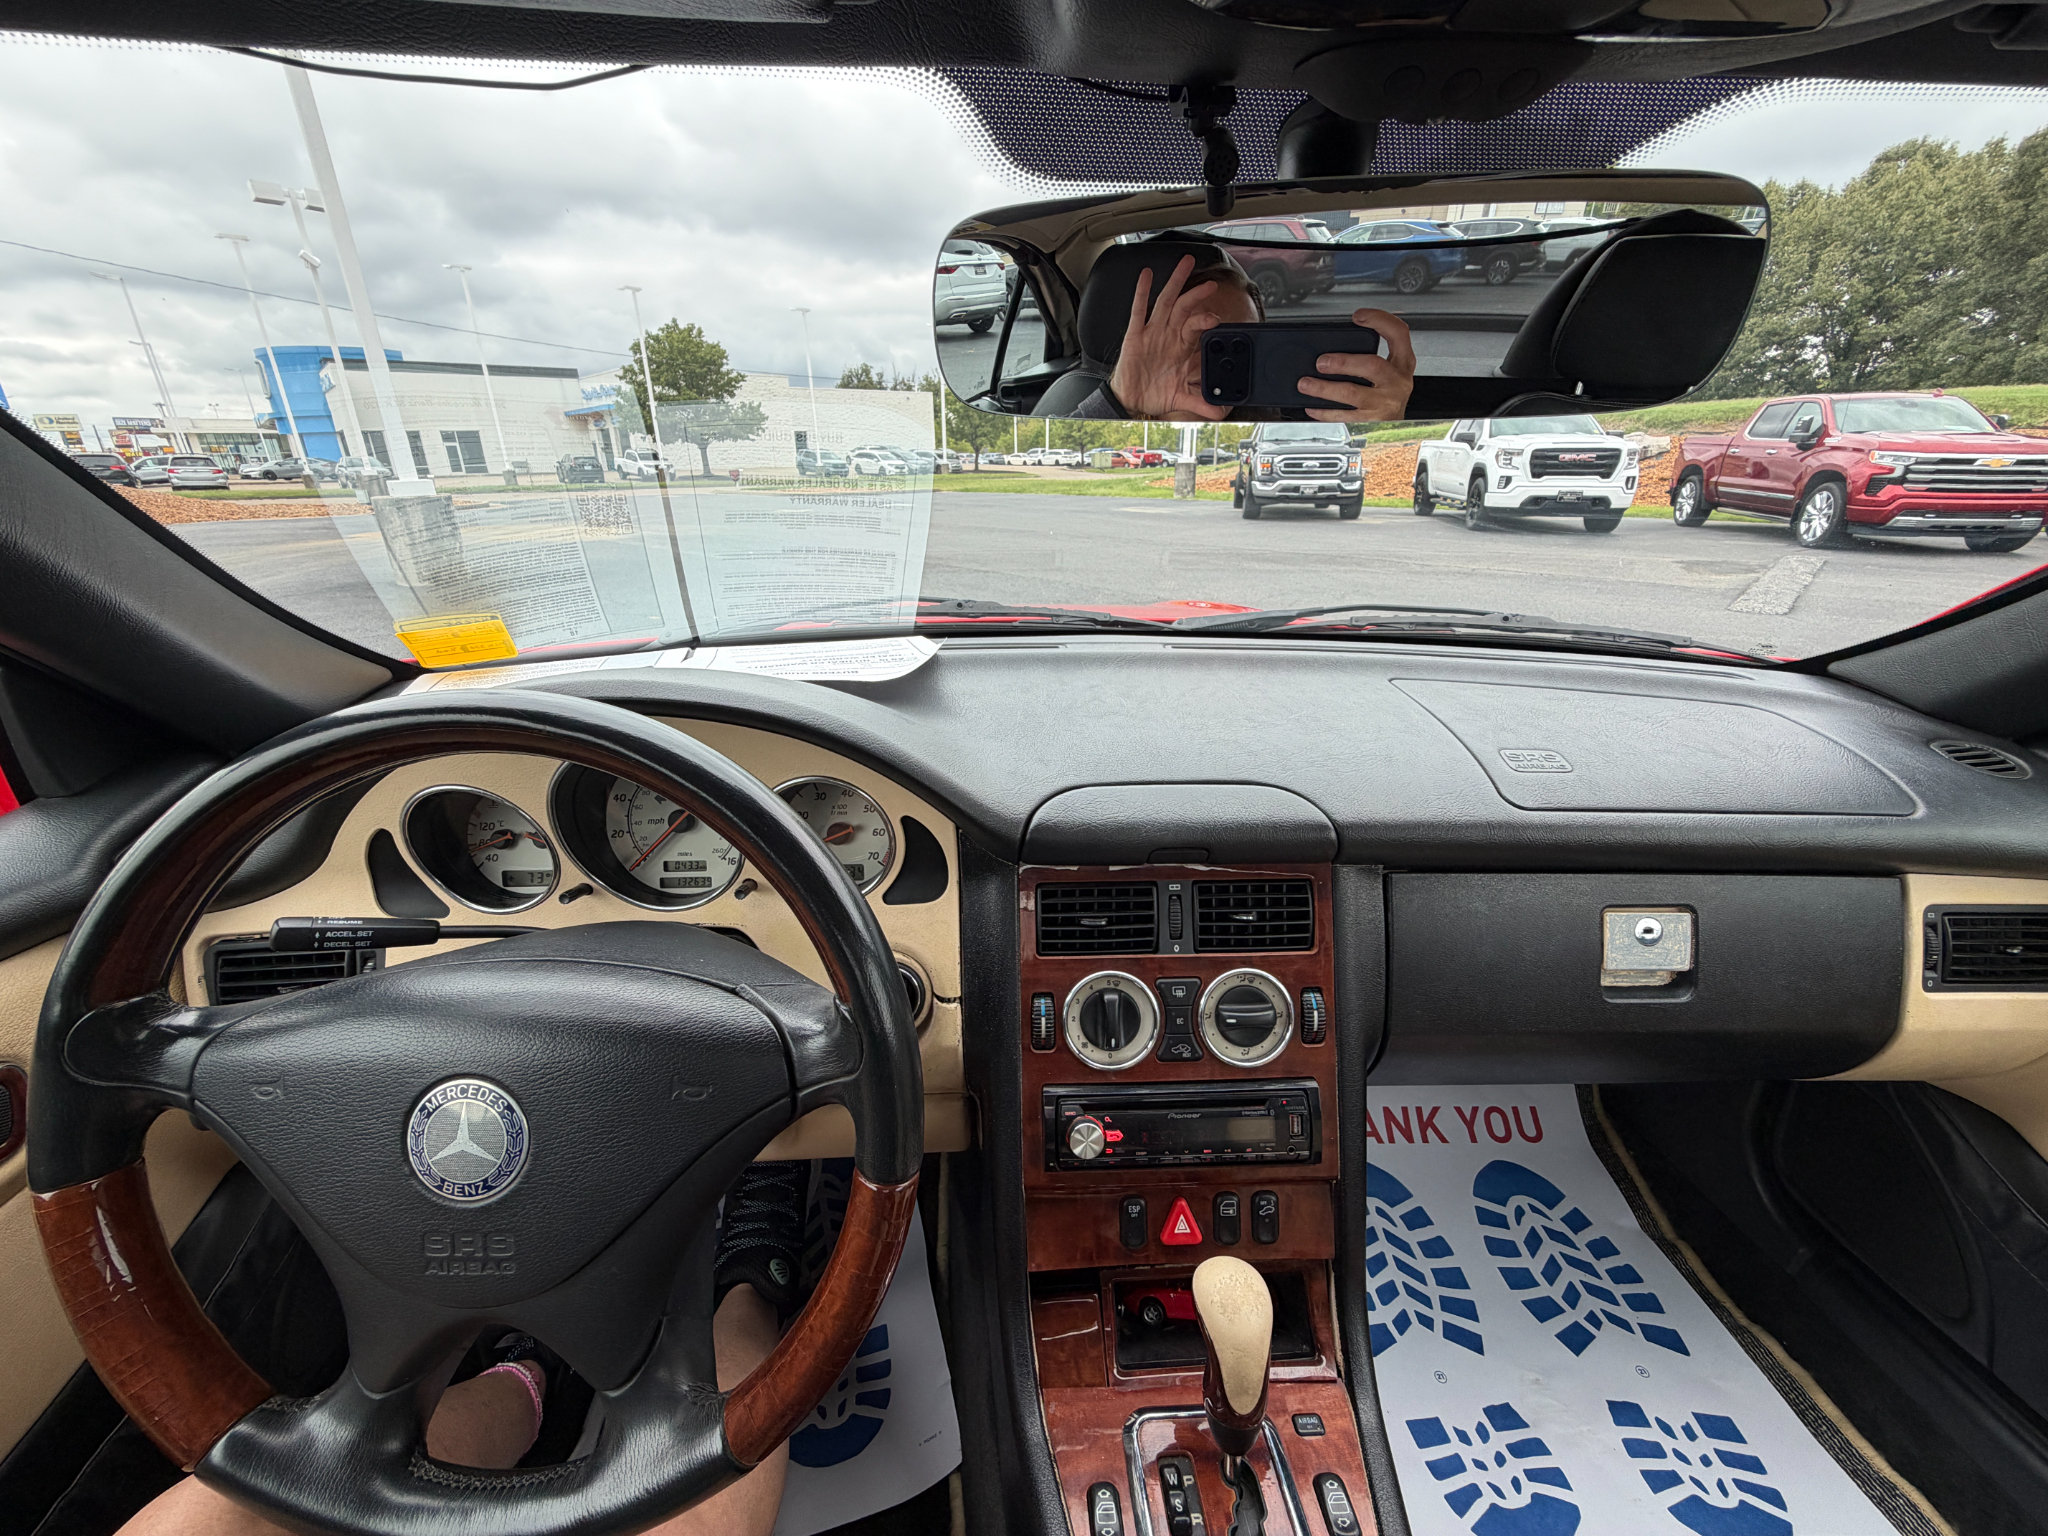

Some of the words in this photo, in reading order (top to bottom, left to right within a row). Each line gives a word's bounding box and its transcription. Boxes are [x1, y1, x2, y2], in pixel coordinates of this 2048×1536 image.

[1558, 454, 1597, 462] GMC
[1505, 752, 1561, 762] SRS
[613, 794, 626, 802] 40
[814, 792, 826, 800] 30
[842, 789, 854, 798] 40
[648, 817, 664, 825] mph
[479, 822, 496, 831] 120
[611, 830, 624, 838] 20
[872, 828, 886, 837] 60
[485, 854, 499, 862] 40
[867, 852, 880, 860] 70
[676, 877, 712, 886] 132639
[424, 1084, 508, 1112] MERCEDES
[1454, 1106, 1544, 1144] YOU
[442, 1182, 488, 1197] BENZ
[1128, 1205, 1141, 1213] ESP
[424, 1232, 516, 1257] SRS
[424, 1262, 516, 1276] AIRBAG
[1166, 1473, 1178, 1486] W
[1182, 1474, 1194, 1488] P
[1174, 1499, 1183, 1512] S
[1190, 1512, 1204, 1526] R
